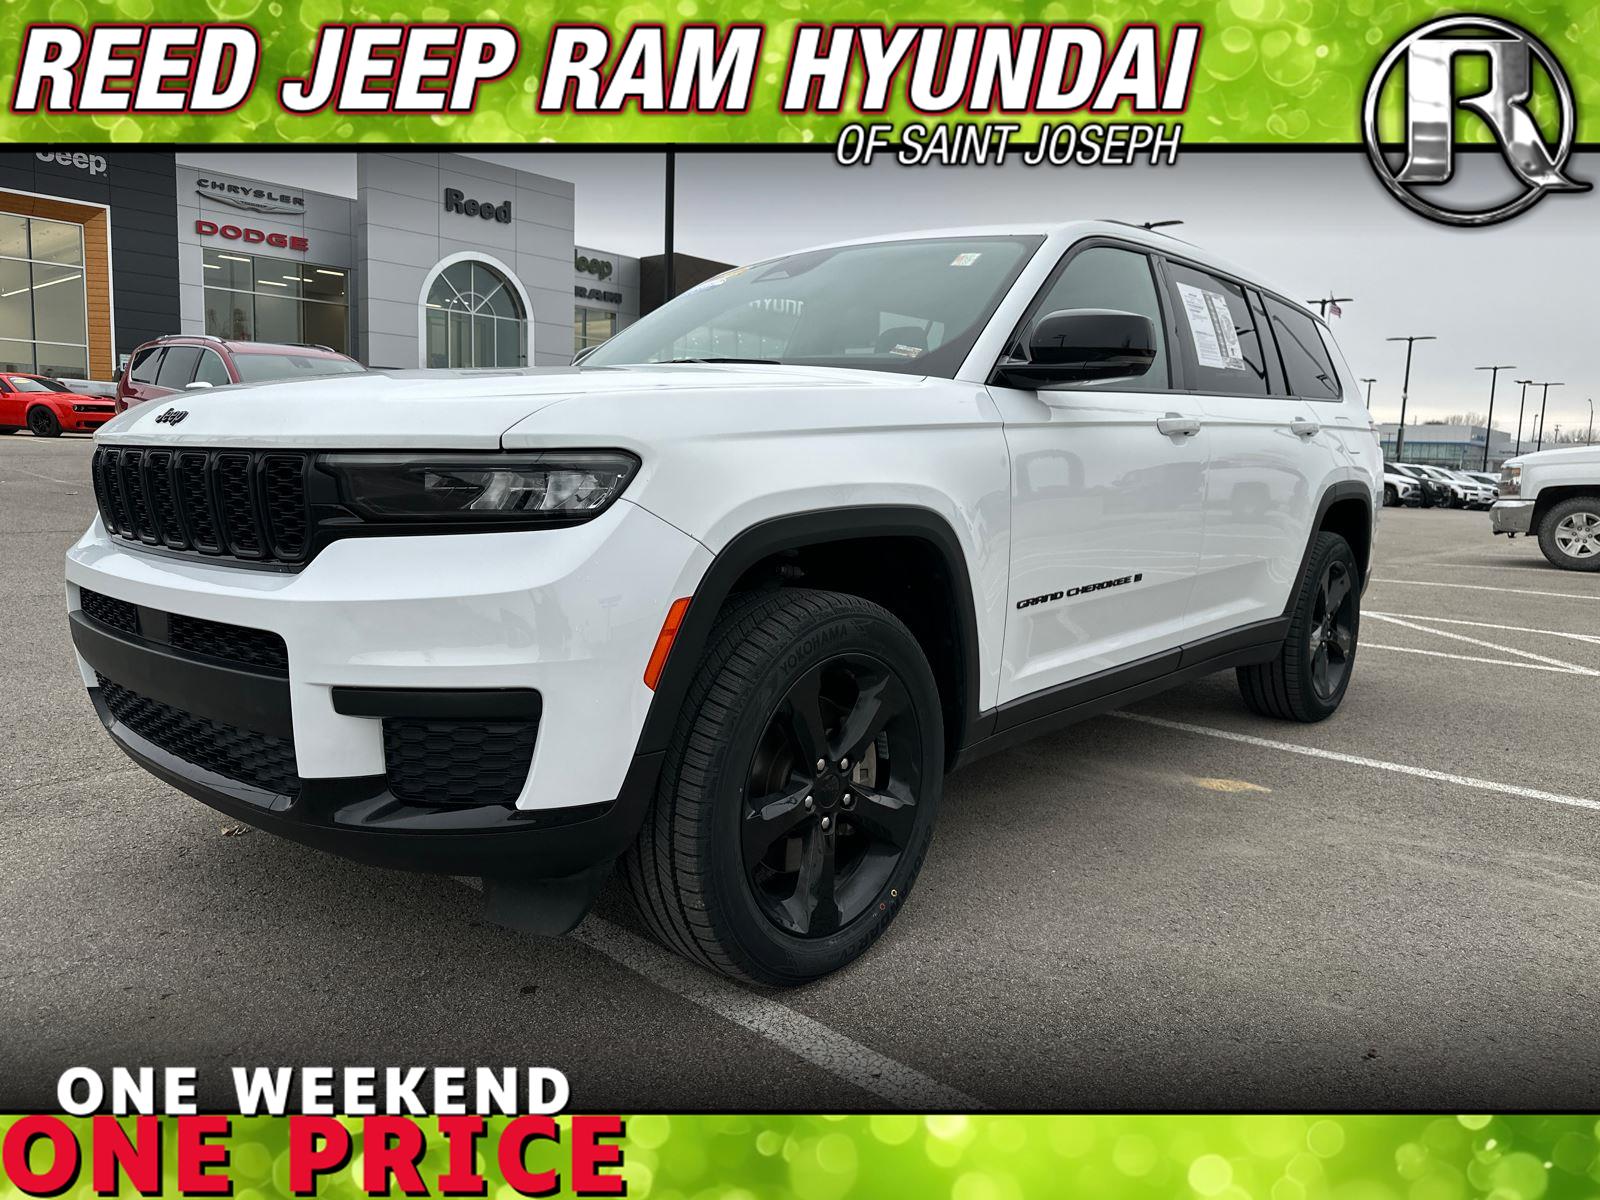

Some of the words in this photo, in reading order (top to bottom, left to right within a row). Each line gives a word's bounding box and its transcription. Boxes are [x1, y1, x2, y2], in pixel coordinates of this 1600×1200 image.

[197, 179, 304, 206] CHRYSLER
[445, 188, 512, 224] Reed
[196, 220, 309, 252] DODGE
[575, 249, 613, 281] eep
[155, 408, 189, 426] Jeep
[1016, 591, 1064, 610] GRAND
[1066, 575, 1132, 597] CHEROKEE
[780, 623, 849, 674] YOKOHAMA
